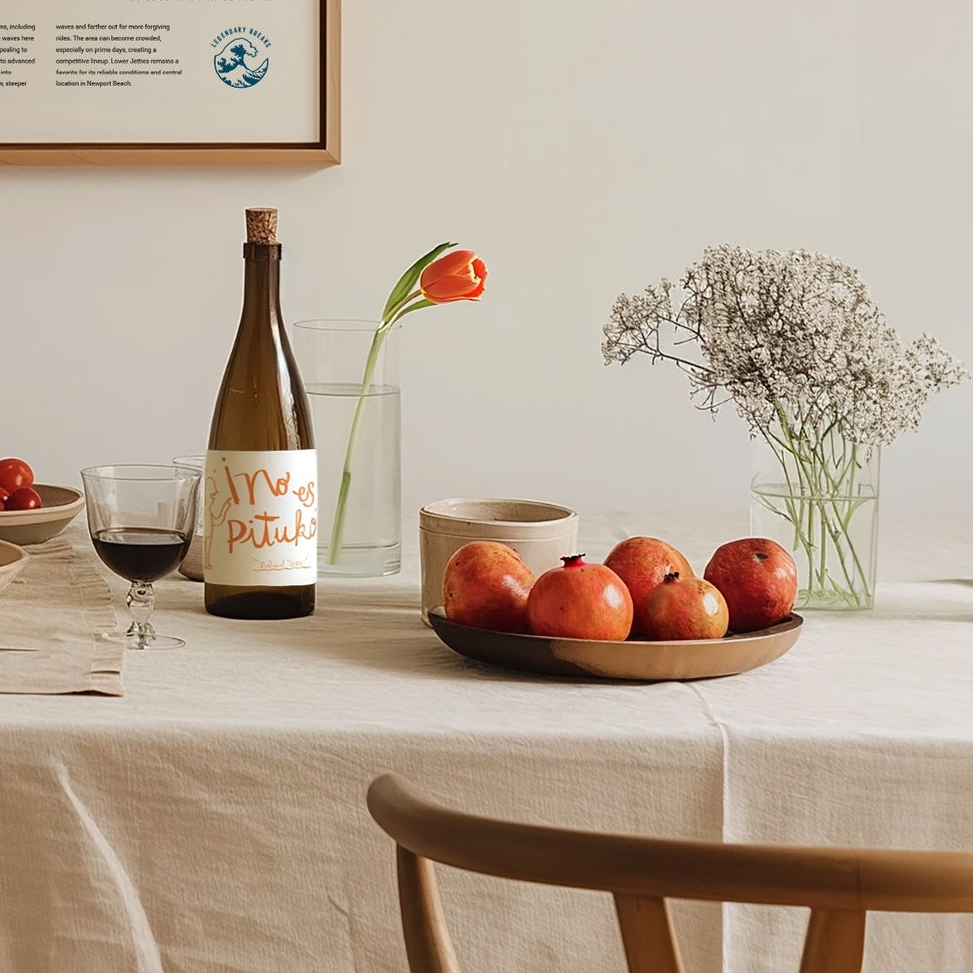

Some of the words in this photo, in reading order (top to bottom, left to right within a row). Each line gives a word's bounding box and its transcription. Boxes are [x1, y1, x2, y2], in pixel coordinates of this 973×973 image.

[211, 27, 246, 47] LEGENDARY
[249, 29, 271, 47] BREAKS
[293, 481, 314, 507] es
